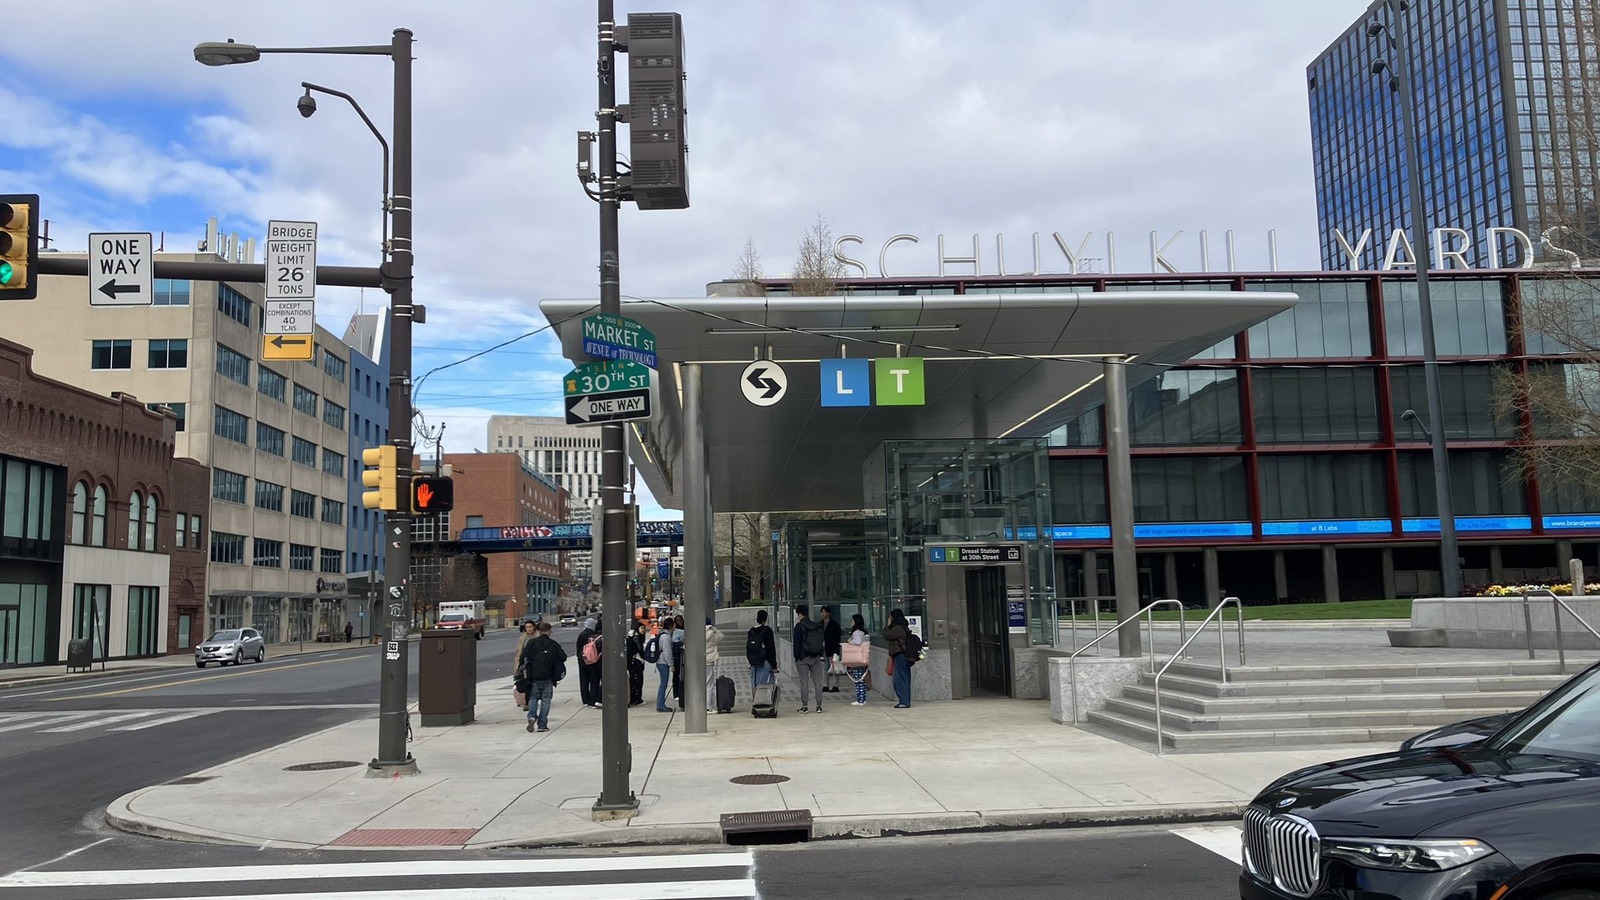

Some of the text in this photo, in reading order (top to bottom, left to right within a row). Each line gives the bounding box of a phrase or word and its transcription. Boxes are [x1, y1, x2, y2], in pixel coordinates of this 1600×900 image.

[272, 227, 312, 238] BRIDGE
[101, 239, 139, 255] ONE
[271, 242, 312, 253] WEIGHT
[1333, 226, 1581, 270] YARDS
[100, 259, 141, 275] WAY
[277, 255, 305, 265] LIMIT
[277, 267, 304, 282] 26
[278, 285, 303, 294] TONS
[282, 317, 296, 325] 40
[585, 320, 654, 351] MARKET ST
[581, 372, 646, 393] 30TH ST
[836, 369, 910, 394] L T
[590, 398, 641, 414] ONE WAY
[934, 551, 941, 559] L
